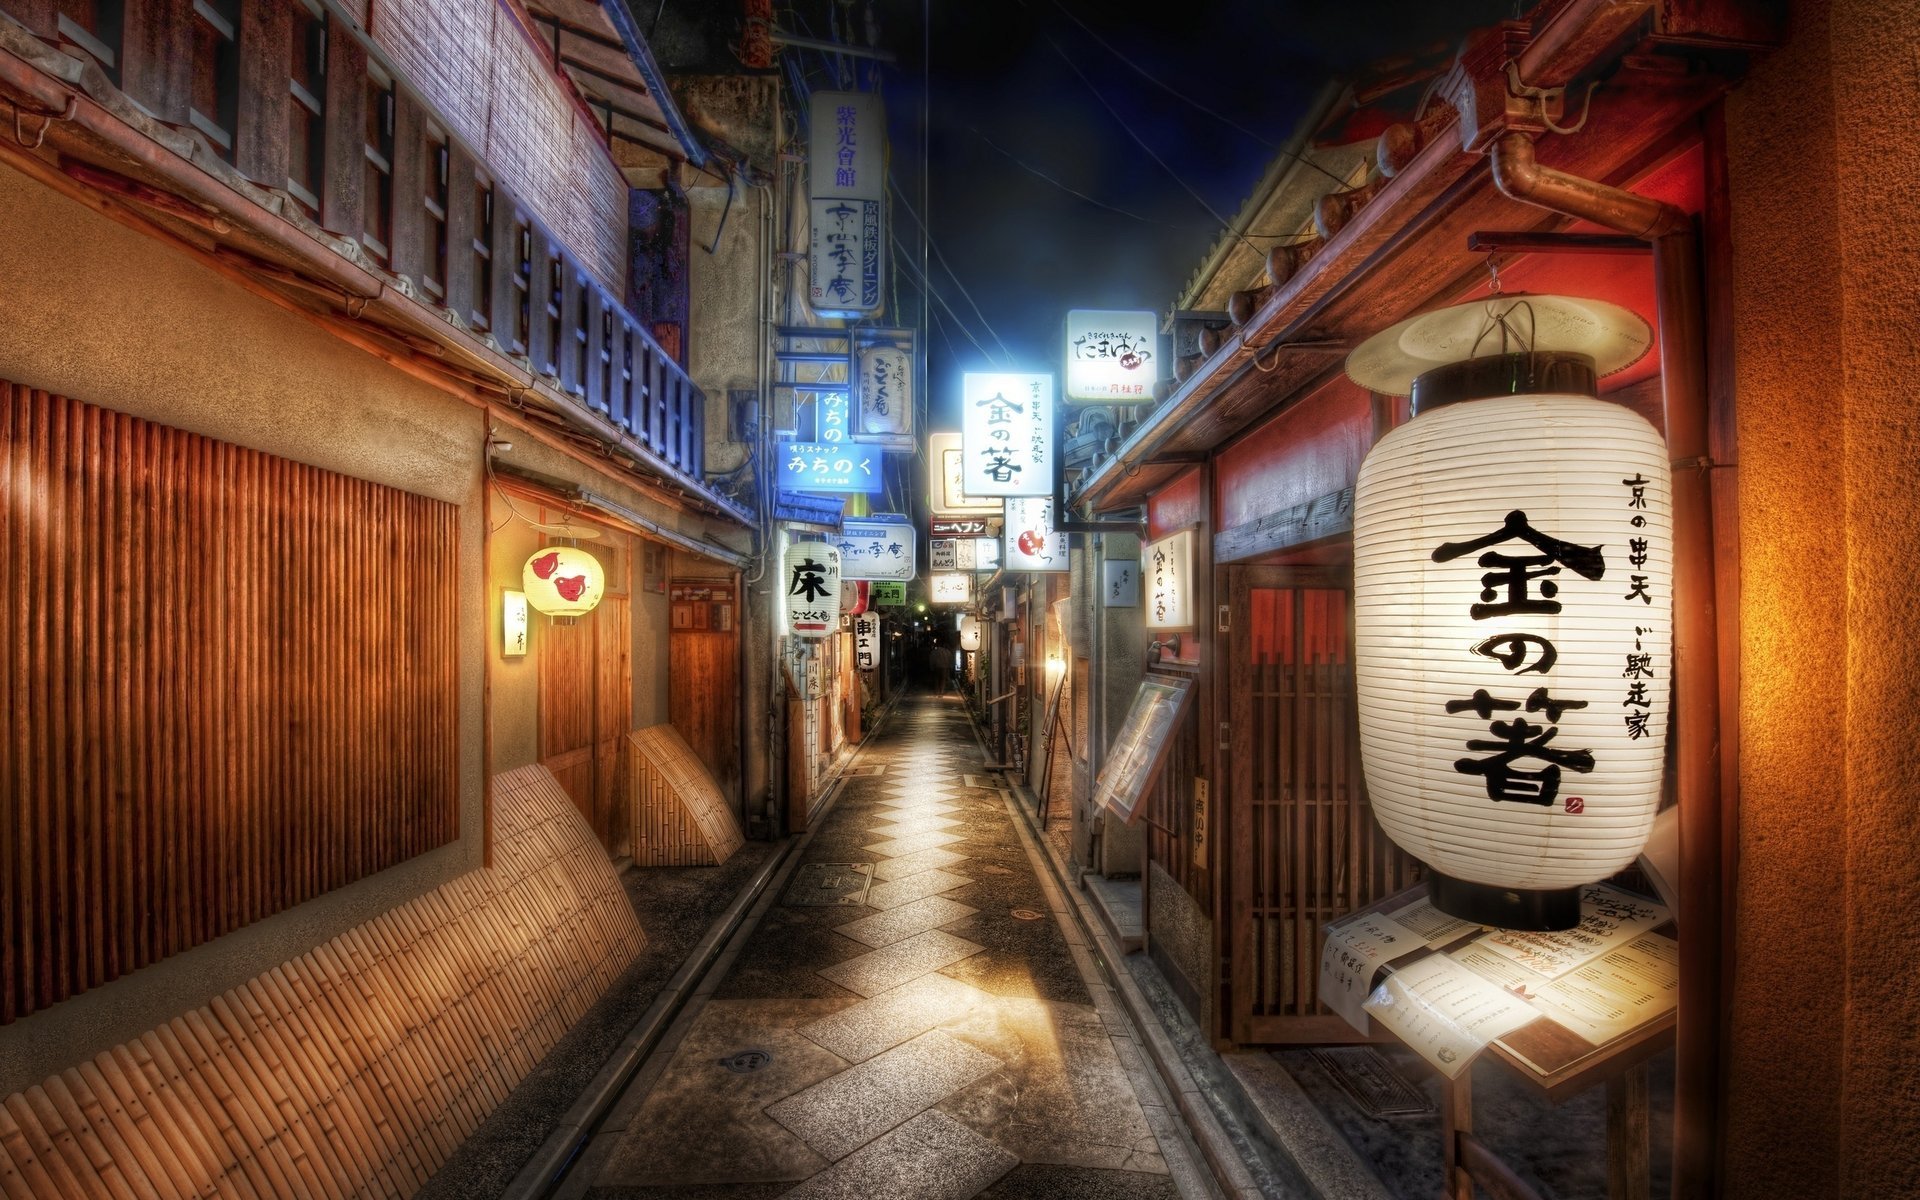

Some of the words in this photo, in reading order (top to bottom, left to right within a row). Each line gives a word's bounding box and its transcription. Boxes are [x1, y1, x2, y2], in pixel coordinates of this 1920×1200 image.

[836, 105, 857, 187] 紫光會館
[787, 456, 871, 475] みちのく
[934, 522, 984, 533] ニューヘブン
[1622, 473, 1652, 605] 京の串天
[788, 558, 833, 604] 床
